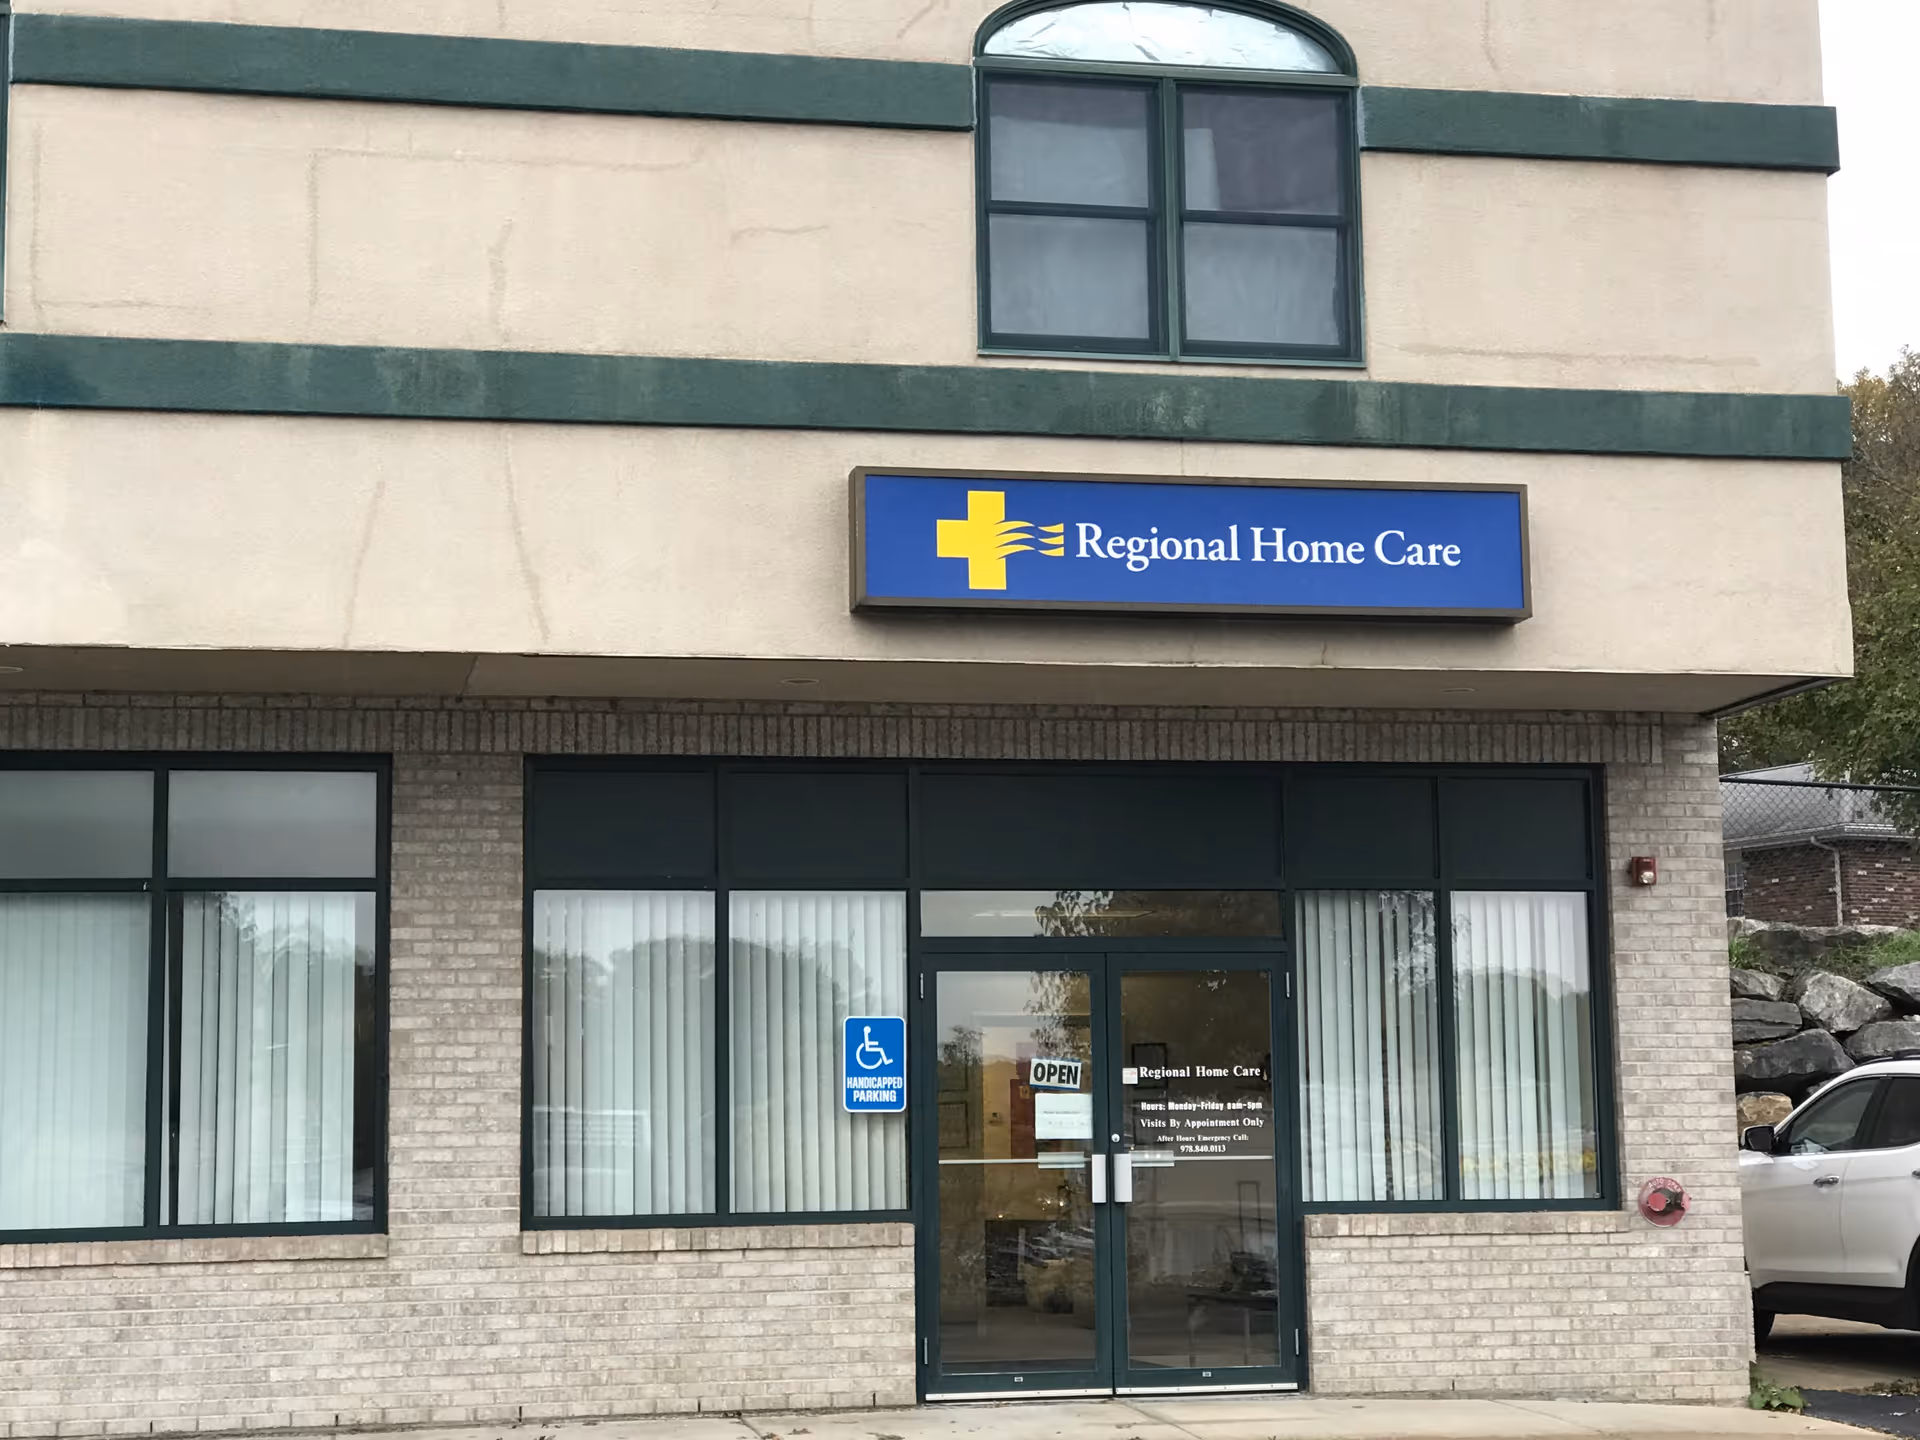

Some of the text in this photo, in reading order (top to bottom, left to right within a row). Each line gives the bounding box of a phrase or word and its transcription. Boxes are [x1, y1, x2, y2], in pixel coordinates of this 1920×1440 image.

[1075, 521, 1461, 571] Regional Home Care
[1033, 1062, 1079, 1085] OPEN
[1139, 1065, 1261, 1080] Regional Home Care
[847, 1077, 902, 1089] HANDICAPPED
[853, 1091, 896, 1103] PARKING
[1141, 1102, 1166, 1111] Hours:
[1168, 1101, 1224, 1111] Monday-Friday
[1140, 1117, 1264, 1129] Visits By Appointment Only
[1198, 1134, 1231, 1142] Emergency
[1180, 1144, 1226, 1153] 978.840.0113
[1648, 1178, 1664, 1188] AUTO
